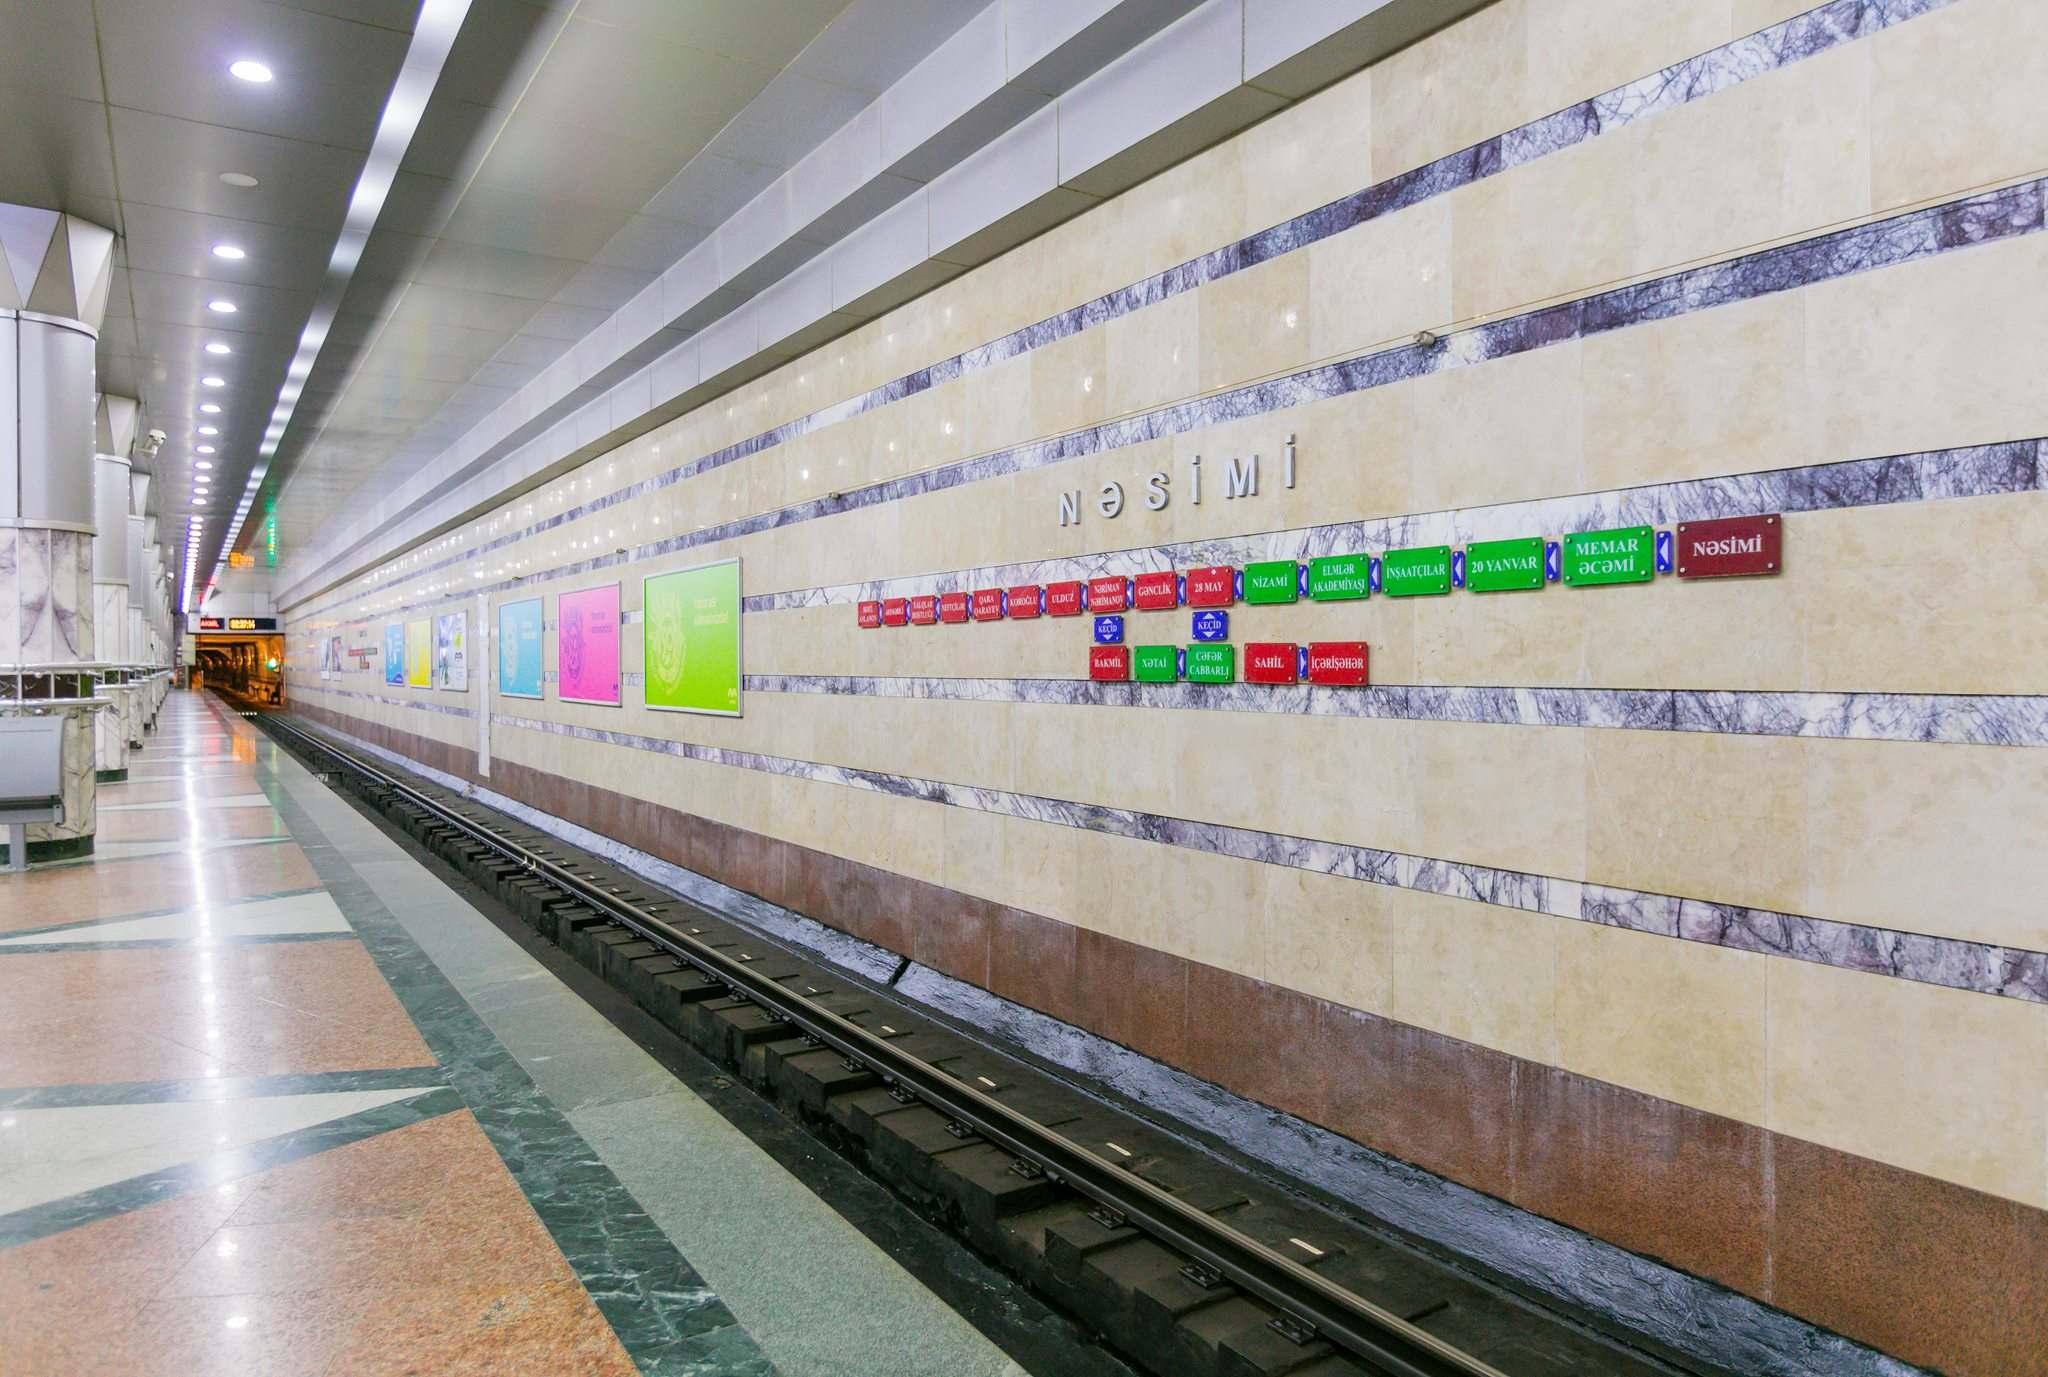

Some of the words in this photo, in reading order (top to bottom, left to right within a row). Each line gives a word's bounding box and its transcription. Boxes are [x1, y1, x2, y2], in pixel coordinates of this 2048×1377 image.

[1059, 433, 1296, 527] NƏSİMİ
[1575, 538, 1639, 556] MEMAR
[1693, 533, 1762, 557] NƏSİMİ
[1322, 563, 1355, 577] ELMLƏR
[1471, 561, 1483, 573] 20
[1486, 556, 1537, 572] YANVAR
[1578, 555, 1635, 575] ƏCƏMİ
[1386, 563, 1445, 581] İNŞAATÇILAR
[1252, 573, 1288, 588] NİZAMİ
[1313, 577, 1365, 593] AKADEMİYASI
[1094, 582, 1120, 594] NƏRİMAN
[1138, 584, 1171, 597] GƏNCLİK
[1194, 583, 1203, 593] 28
[1204, 582, 1223, 592] MAY
[978, 594, 995, 604] QARA
[1051, 592, 1075, 604] ULDUZ
[1098, 623, 1118, 634] KEÇİD
[1197, 618, 1222, 631] KEÇİD
[1094, 656, 1123, 668] BAKMİL
[1142, 656, 1167, 668] XƏTAİ
[1195, 651, 1223, 662] CƏFƏR
[1255, 655, 1284, 669] SAHİL
[1189, 665, 1229, 676] CABBARLI
[1311, 656, 1364, 672] İÇƏRİŞƏHƏR
